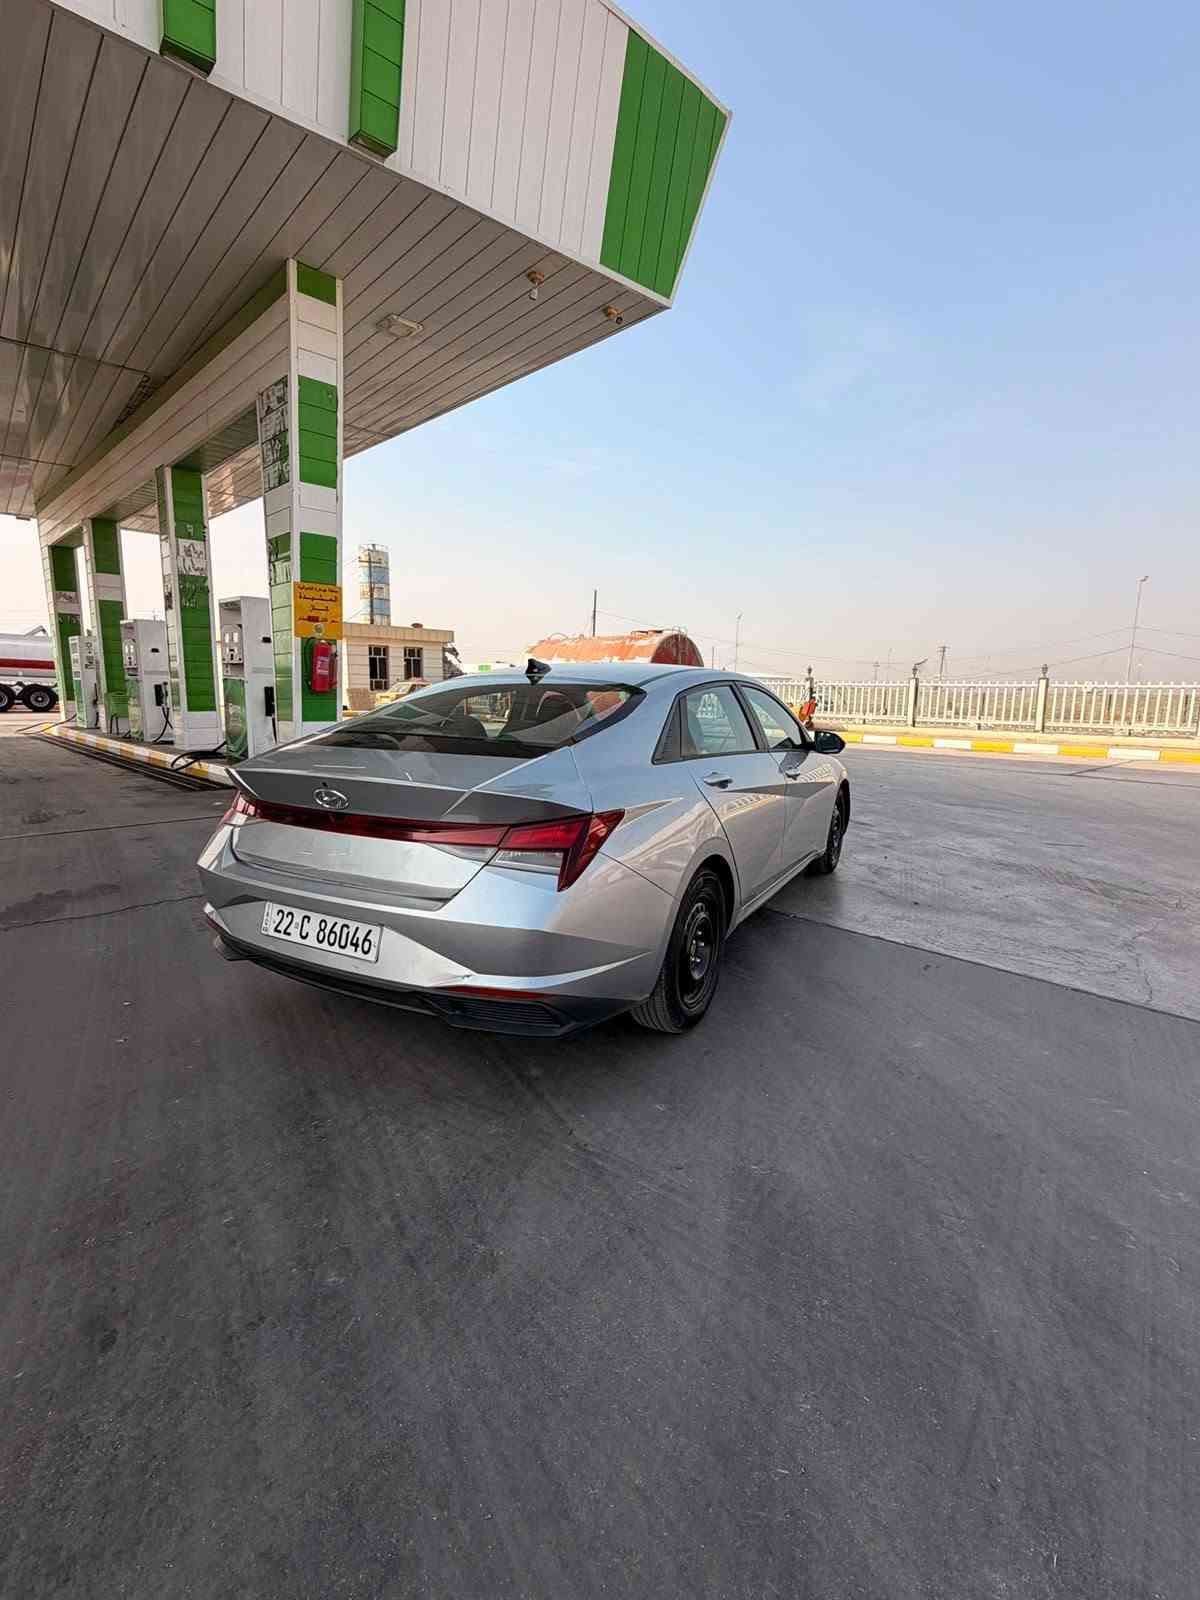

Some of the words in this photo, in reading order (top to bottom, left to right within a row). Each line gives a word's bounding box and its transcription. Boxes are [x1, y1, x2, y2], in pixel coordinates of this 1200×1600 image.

[274, 909, 294, 936] 22
[300, 915, 311, 940] C
[316, 919, 373, 955] 86046
